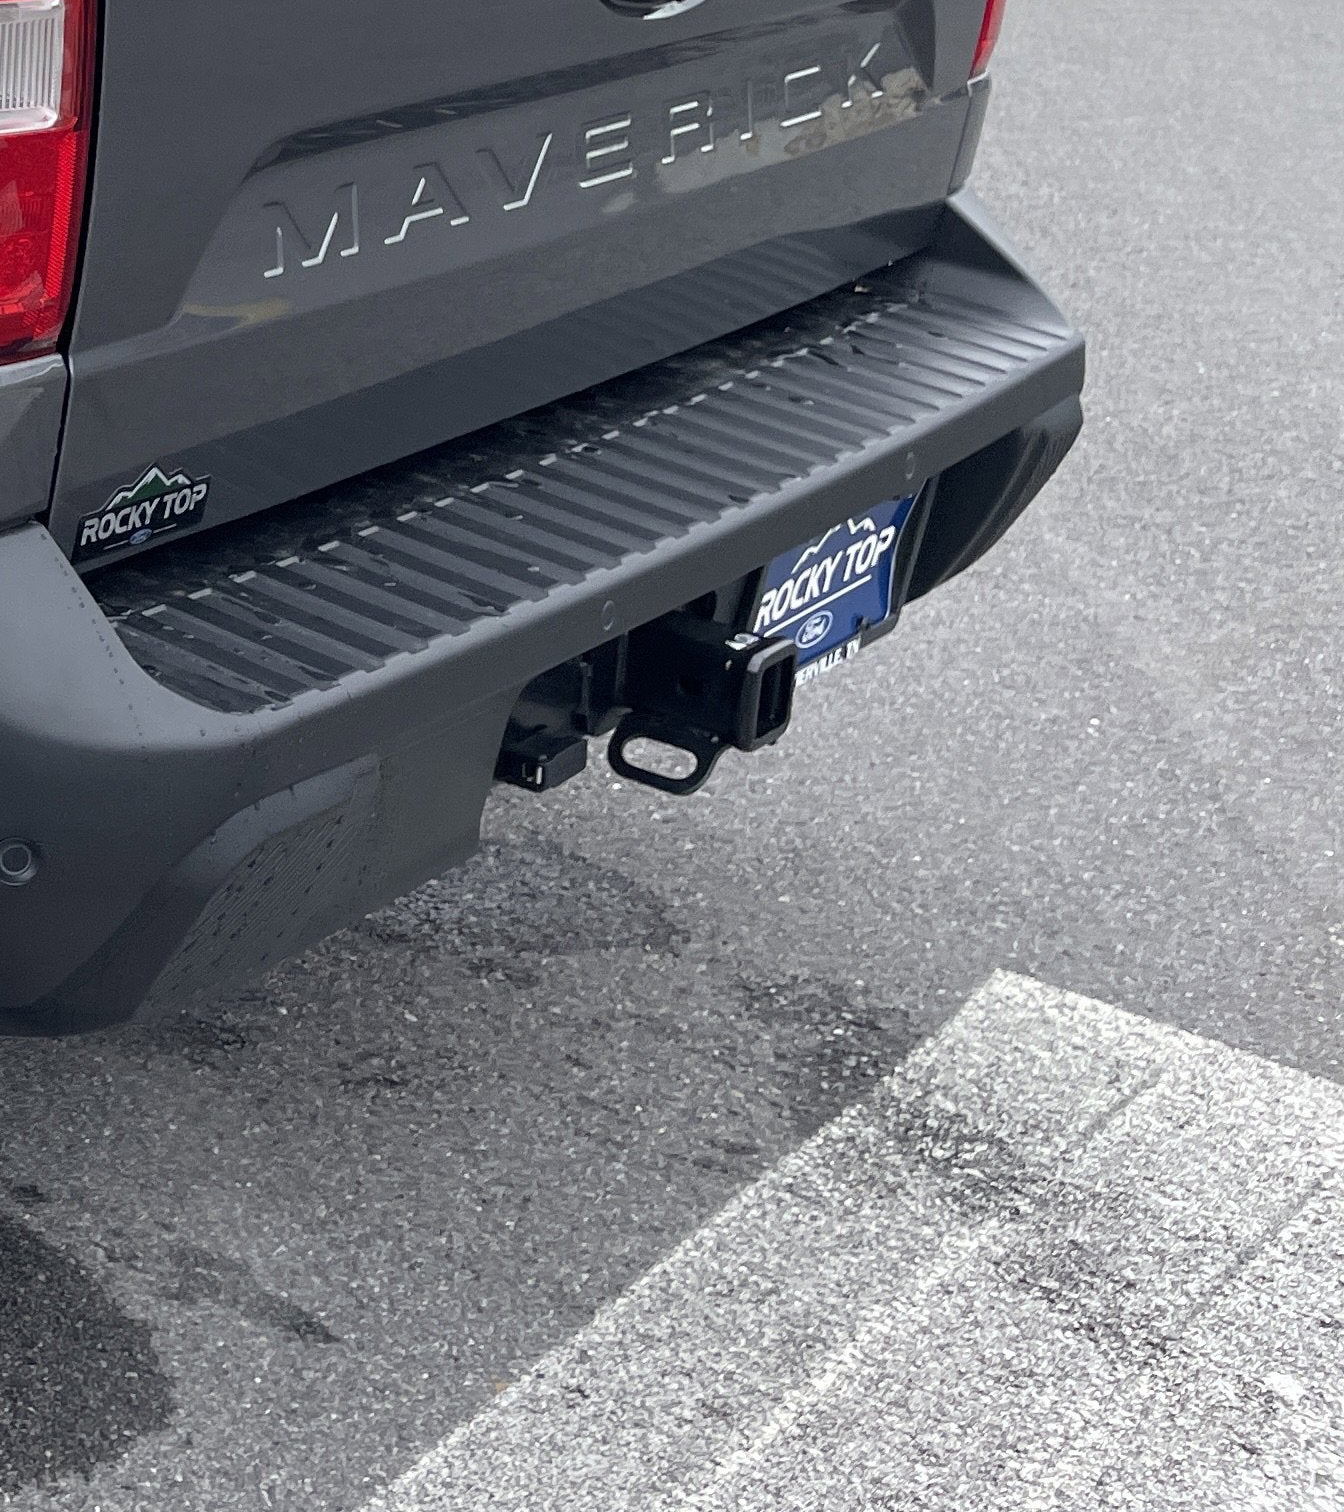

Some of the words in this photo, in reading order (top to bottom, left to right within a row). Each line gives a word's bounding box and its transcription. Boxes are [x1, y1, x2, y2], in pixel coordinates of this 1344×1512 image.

[263, 42, 886, 278] MAVERICK
[80, 497, 161, 547] ROCKY
[163, 483, 208, 520] TOP
[753, 550, 844, 634] ROCKY
[843, 524, 897, 582] TOP
